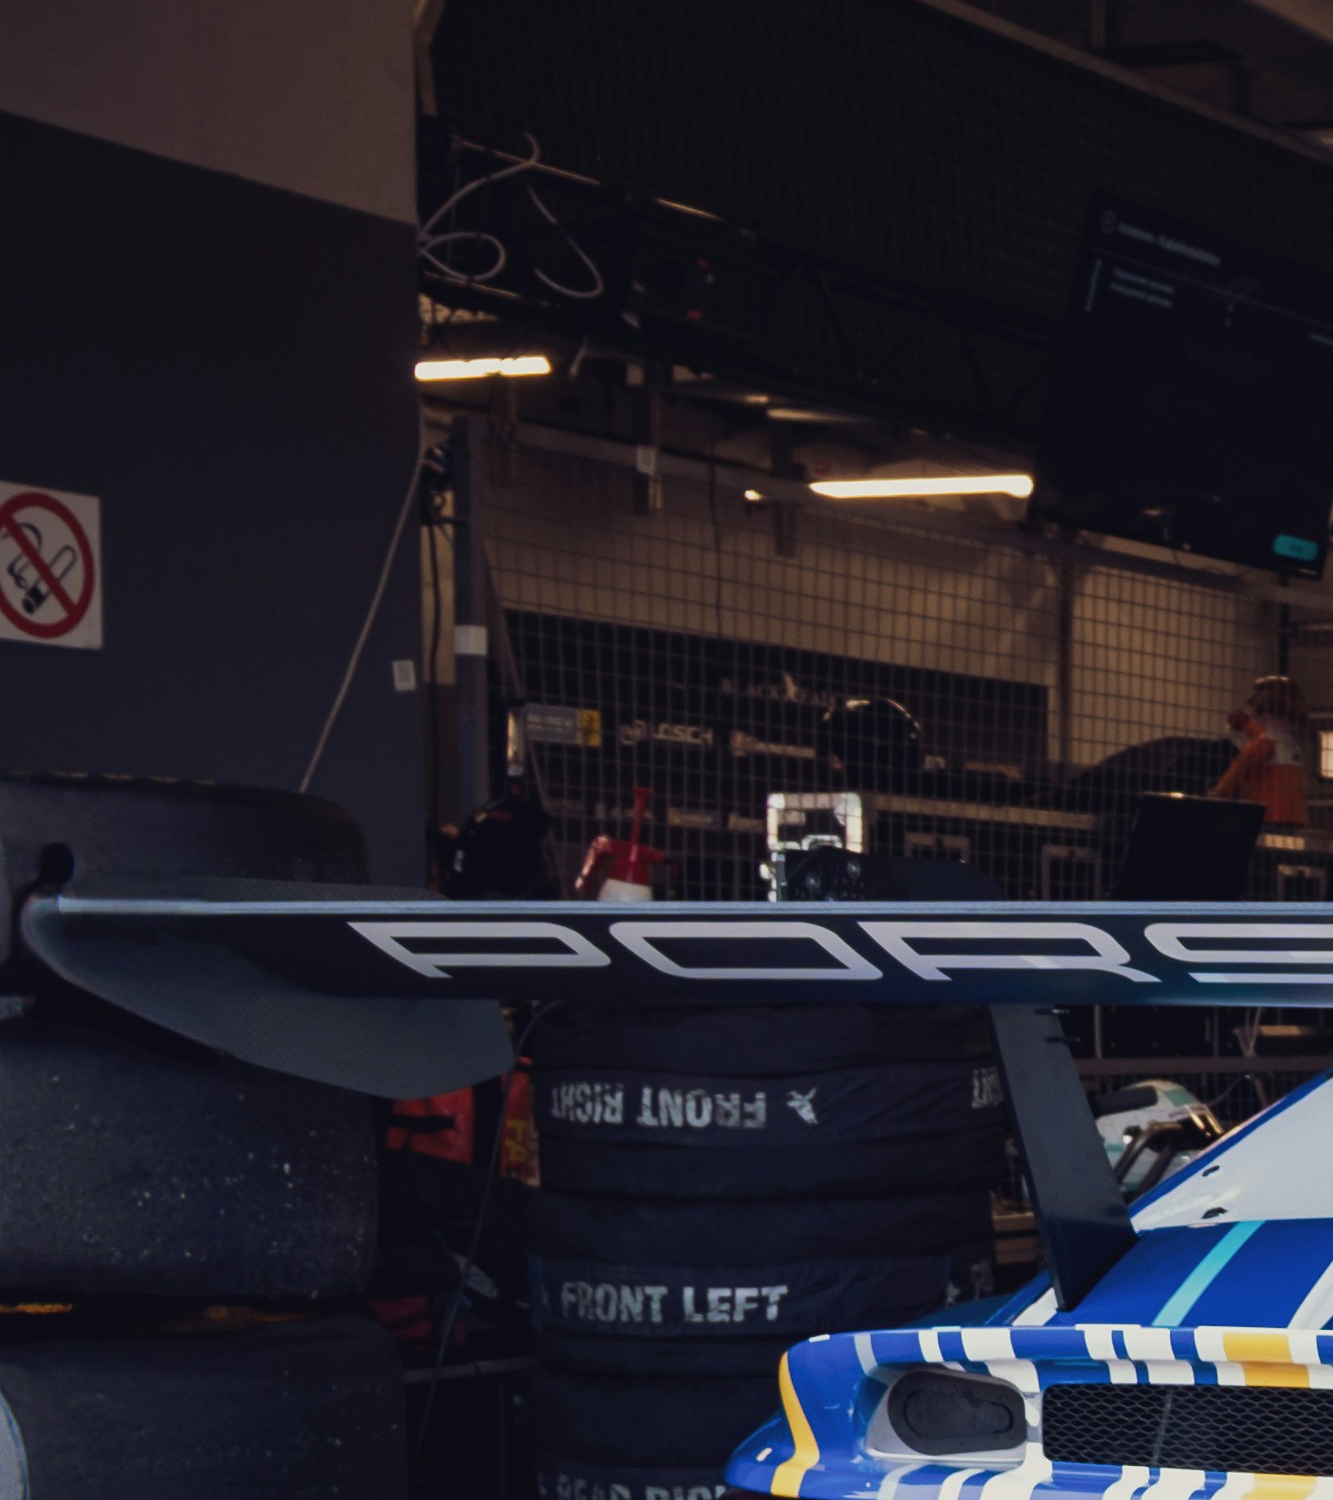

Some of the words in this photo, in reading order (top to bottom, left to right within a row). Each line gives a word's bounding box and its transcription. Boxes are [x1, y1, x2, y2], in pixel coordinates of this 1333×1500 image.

[551, 1080, 624, 1126] RIGHT
[637, 1085, 767, 1129] FRONT
[561, 1280, 668, 1324] FRONT
[682, 1283, 789, 1323] LEFT
